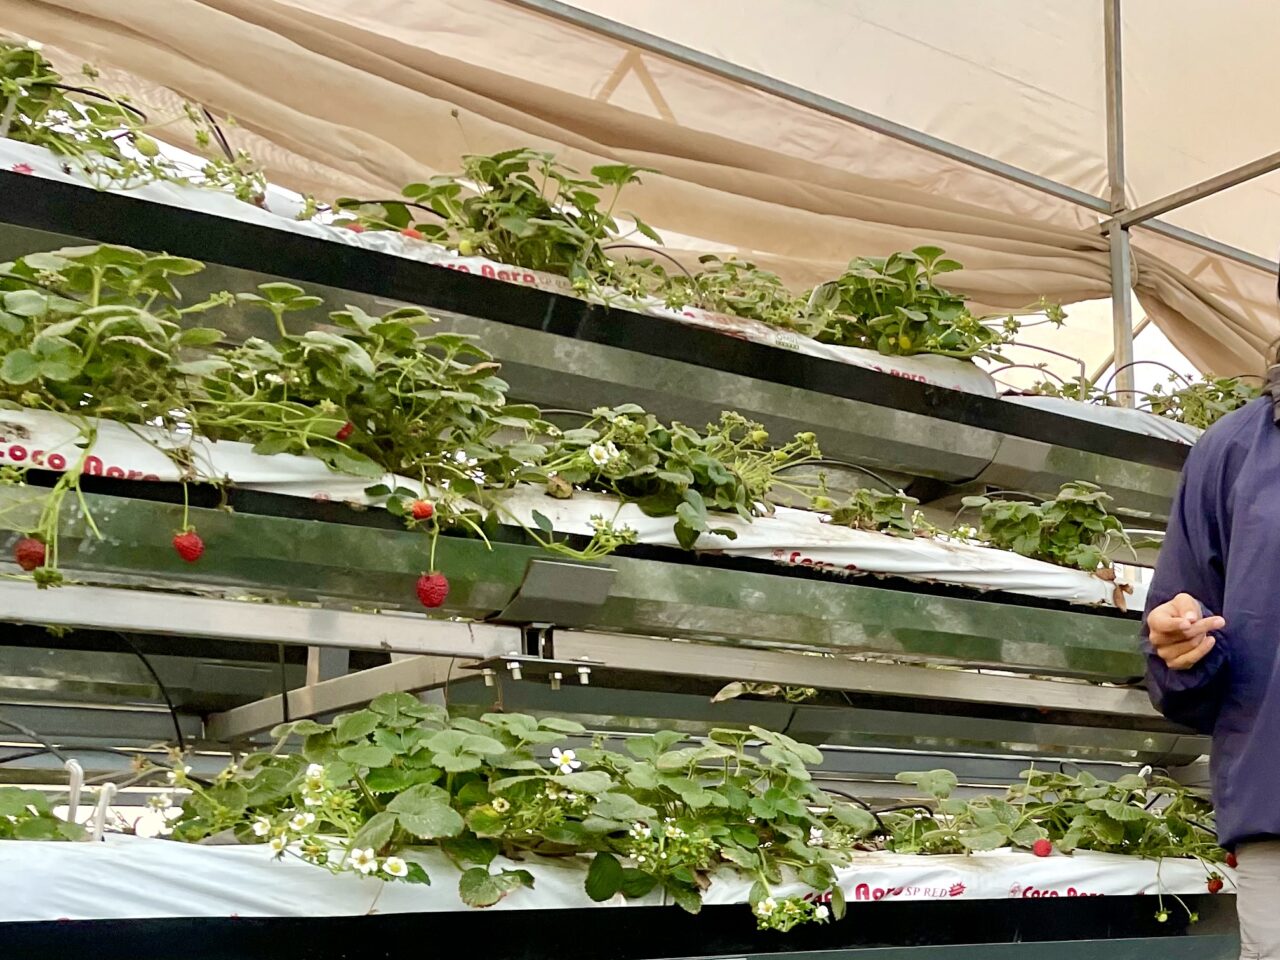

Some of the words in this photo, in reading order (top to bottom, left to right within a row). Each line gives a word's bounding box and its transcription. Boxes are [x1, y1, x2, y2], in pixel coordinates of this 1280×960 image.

[0, 445, 66, 470] oco
[905, 886, 921, 897] SP
[923, 887, 948, 899] RED
